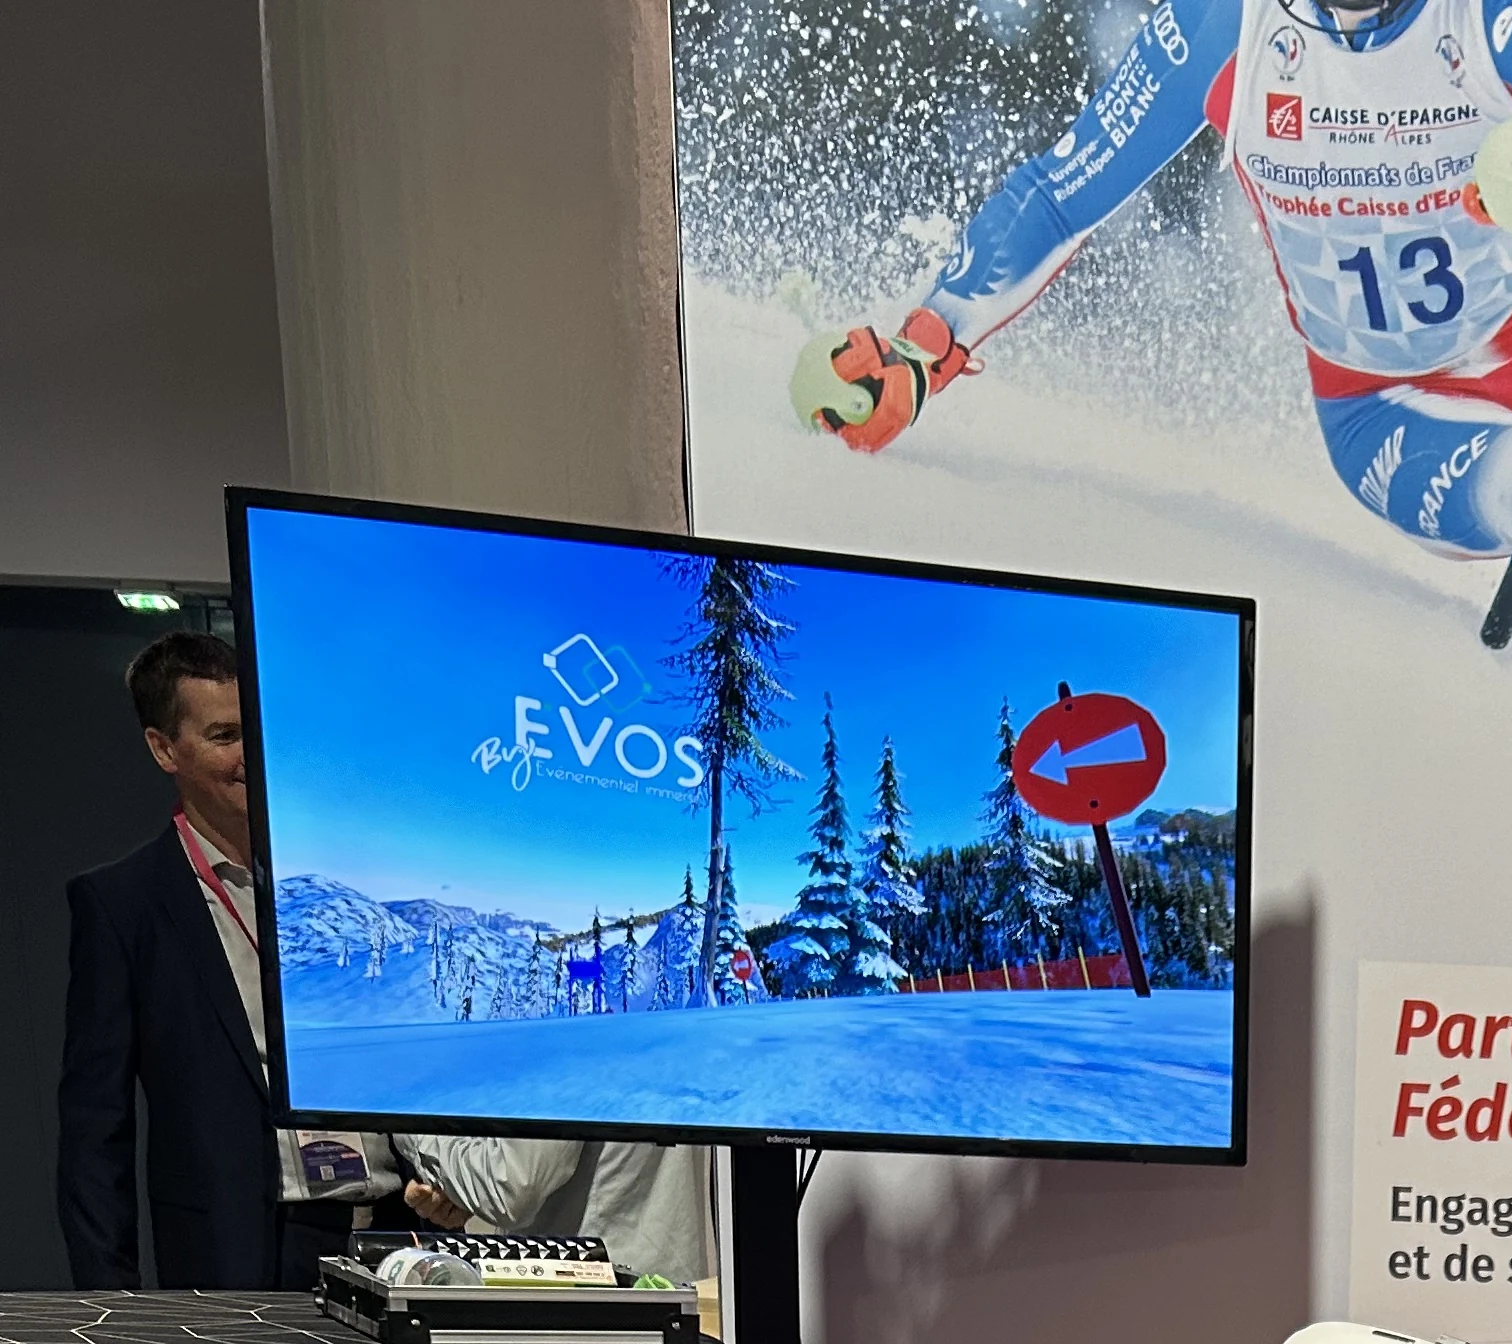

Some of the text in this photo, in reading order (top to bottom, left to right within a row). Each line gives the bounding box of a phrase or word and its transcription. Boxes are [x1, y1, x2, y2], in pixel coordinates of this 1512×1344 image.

[1095, 43, 1140, 116] SAVOIE
[1101, 70, 1140, 132] MONT
[1110, 73, 1161, 149] BLANC
[1309, 107, 1370, 125] CAISSE
[1329, 124, 1432, 147] RHÔNE ALPES
[1246, 153, 1401, 191] Championnats
[1404, 161, 1434, 187] de
[1337, 196, 1409, 217] Caisse
[1338, 235, 1465, 332] 13
[514, 695, 706, 787] EVOS
[1388, 1246, 1430, 1281] et
[1443, 1244, 1494, 1283] de
